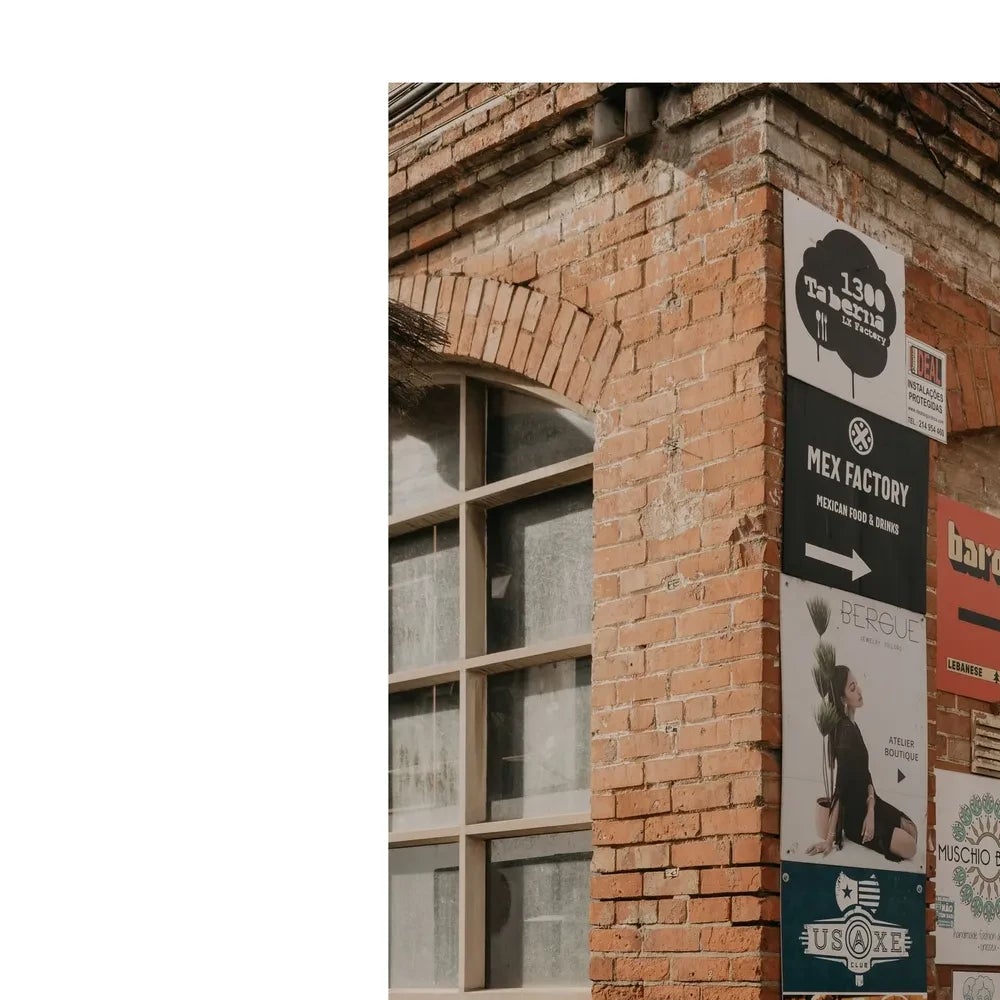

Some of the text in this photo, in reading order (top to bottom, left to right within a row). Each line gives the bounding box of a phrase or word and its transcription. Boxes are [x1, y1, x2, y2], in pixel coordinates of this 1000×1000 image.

[804, 275, 884, 333] Taberna
[841, 272, 886, 312] 1300
[855, 321, 886, 346] Factory
[908, 380, 944, 403] INSTALAÇÕES
[908, 392, 943, 414] PROTEGIDAS
[807, 444, 909, 508] MEX FACTORY
[816, 494, 900, 536] MEXICAN FOOD & DRINKS
[841, 599, 920, 643] BERGUE
[947, 658, 983, 677] LEBANESE
[889, 736, 915, 748] ATELIER
[884, 748, 919, 762] BOUTIQUE
[938, 844, 990, 866] MUSCHIO
